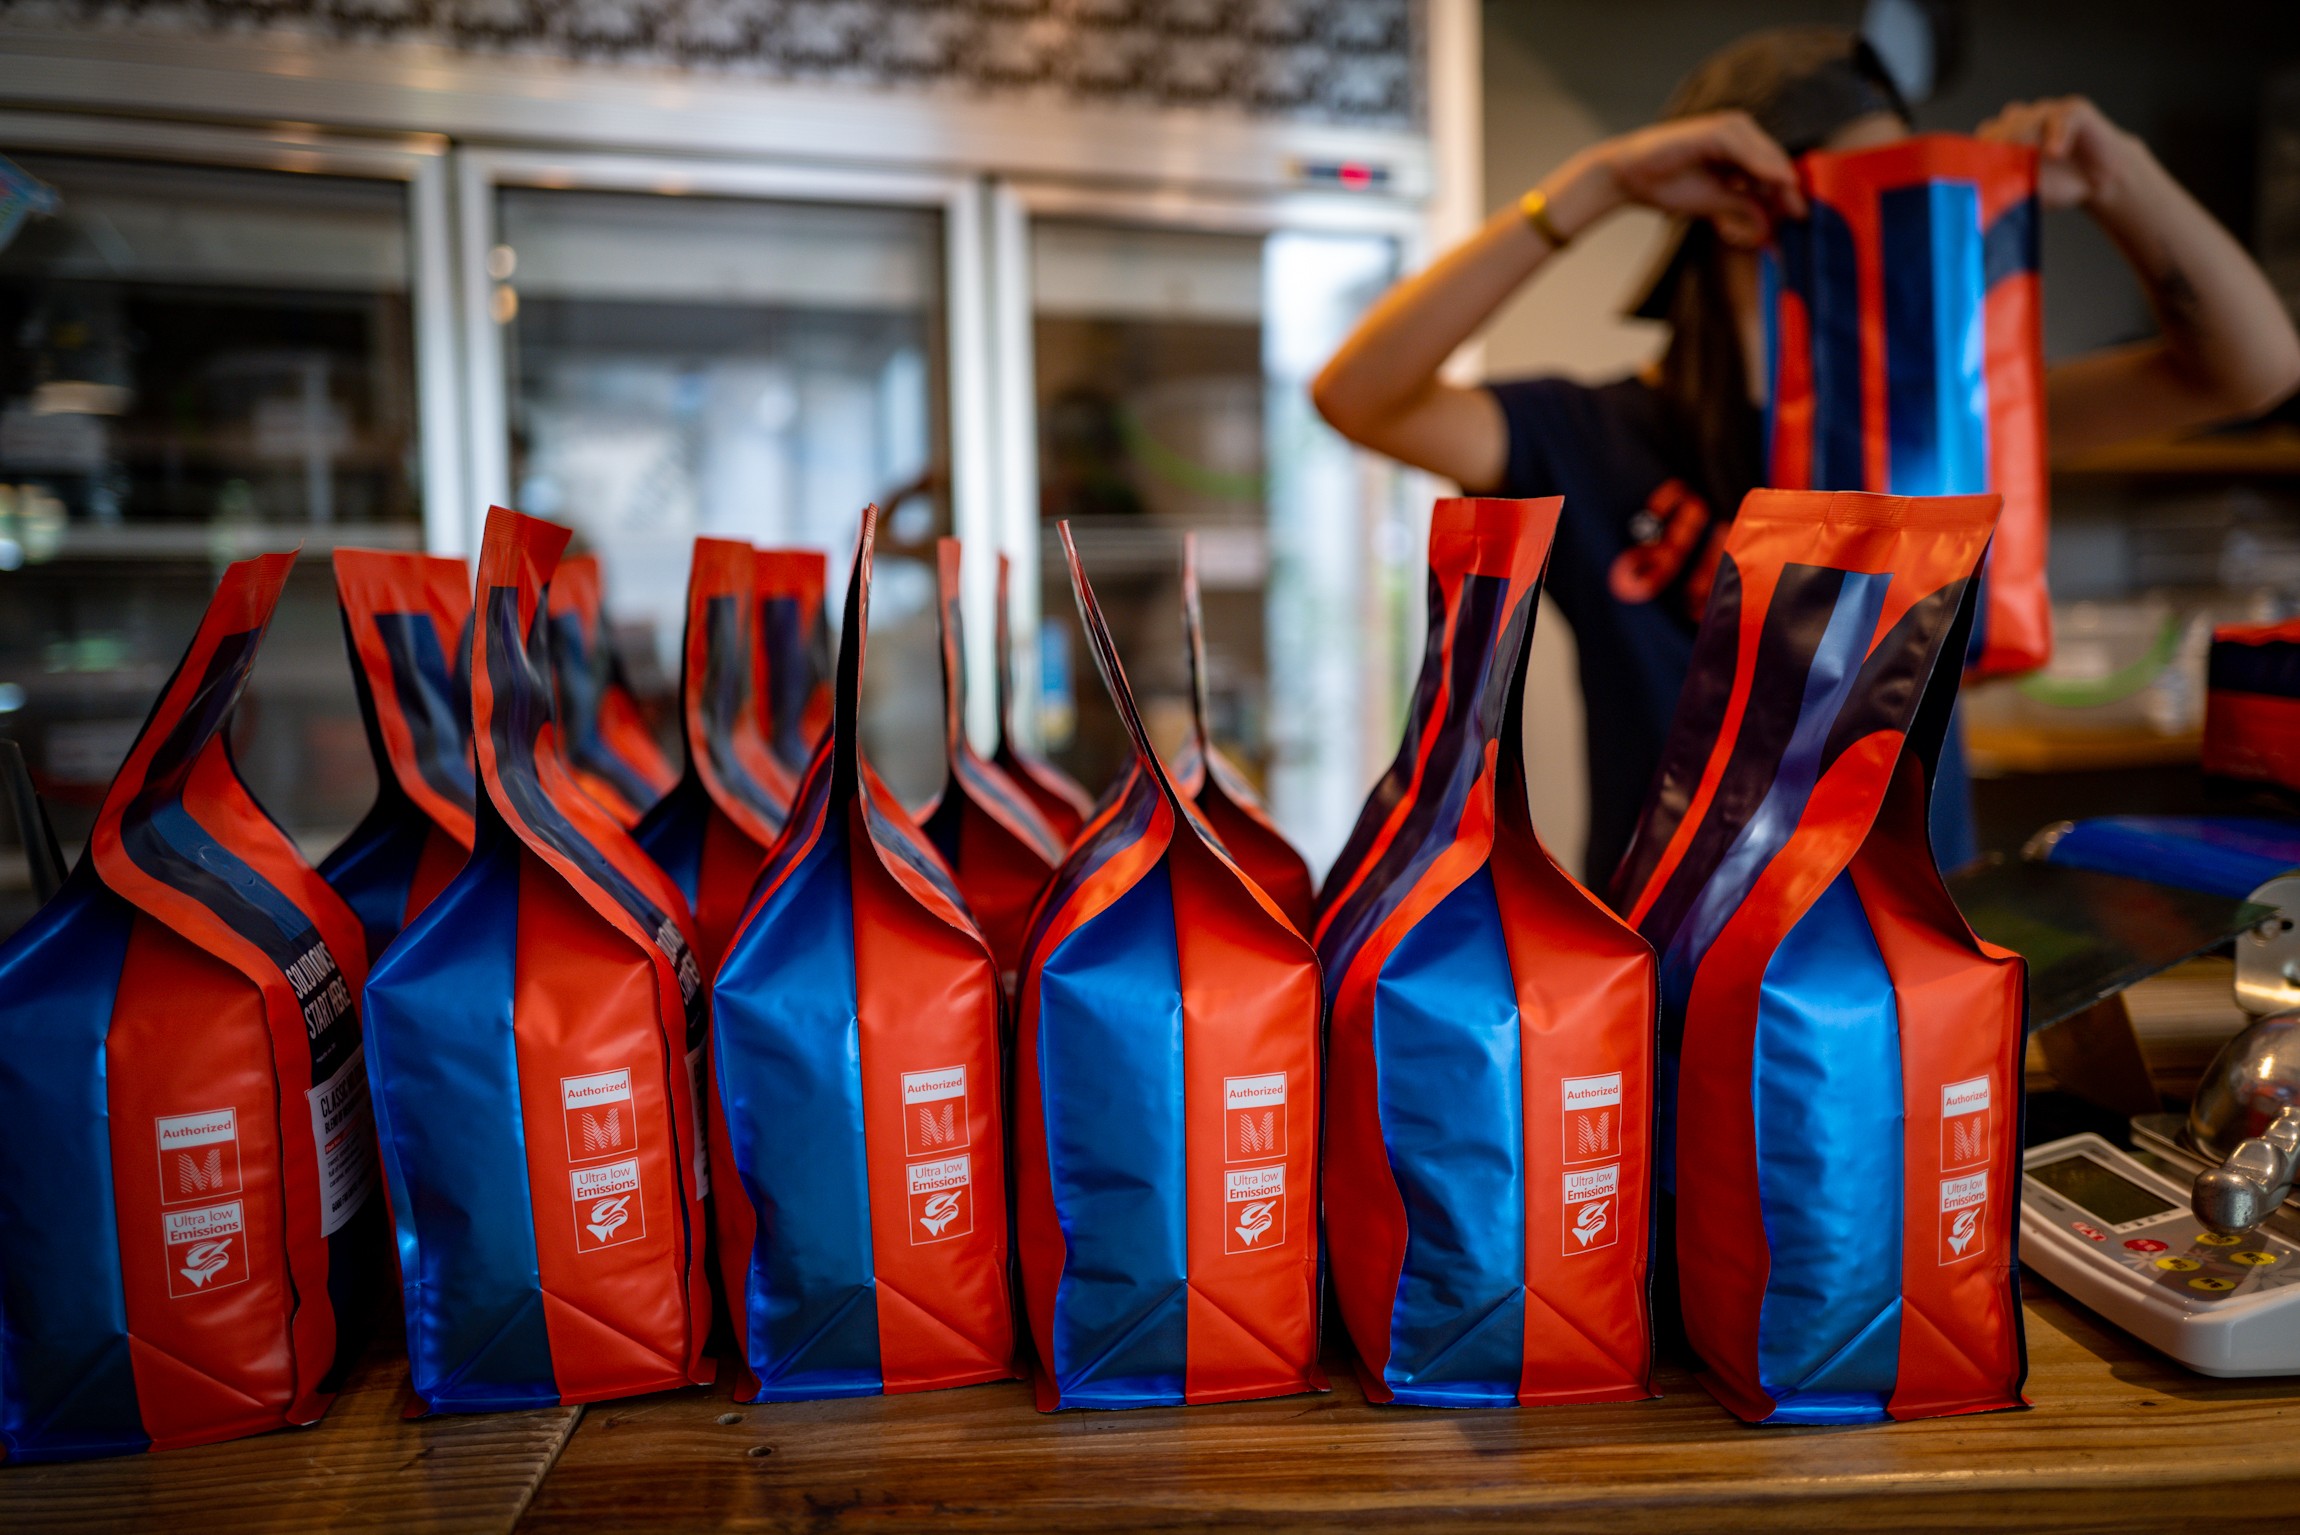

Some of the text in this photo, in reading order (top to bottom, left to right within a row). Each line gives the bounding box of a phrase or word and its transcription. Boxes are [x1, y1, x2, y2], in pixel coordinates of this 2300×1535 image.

[303, 975, 352, 1039] START HERE
[567, 1080, 628, 1099] Authorized
[907, 1077, 963, 1094] Authorized
[1229, 1084, 1284, 1099] Authorized
[1567, 1084, 1619, 1100] Authorized
[1945, 1088, 1988, 1106] Authorized
[163, 1119, 232, 1140] Authorized
[581, 1107, 622, 1151] M
[920, 1103, 955, 1146] M
[1240, 1111, 1274, 1153] M
[1578, 1111, 1610, 1155] M
[1954, 1116, 1982, 1161] M
[178, 1148, 223, 1194] M
[579, 1166, 631, 1185] Ultra low
[915, 1162, 963, 1179] Ultra low
[1233, 1171, 1279, 1186] Ultra low
[1571, 1171, 1612, 1188] Ultra low
[577, 1177, 636, 1198] Emissions
[912, 1174, 967, 1192] Emissions
[1229, 1184, 1281, 1199] Emissions
[1567, 1183, 1614, 1201] Emissions
[1947, 1178, 1983, 1195] Ultra low
[1943, 1191, 1985, 1209] Emissions
[173, 1209, 233, 1229] Ultra low
[169, 1221, 239, 1242] Emissions
